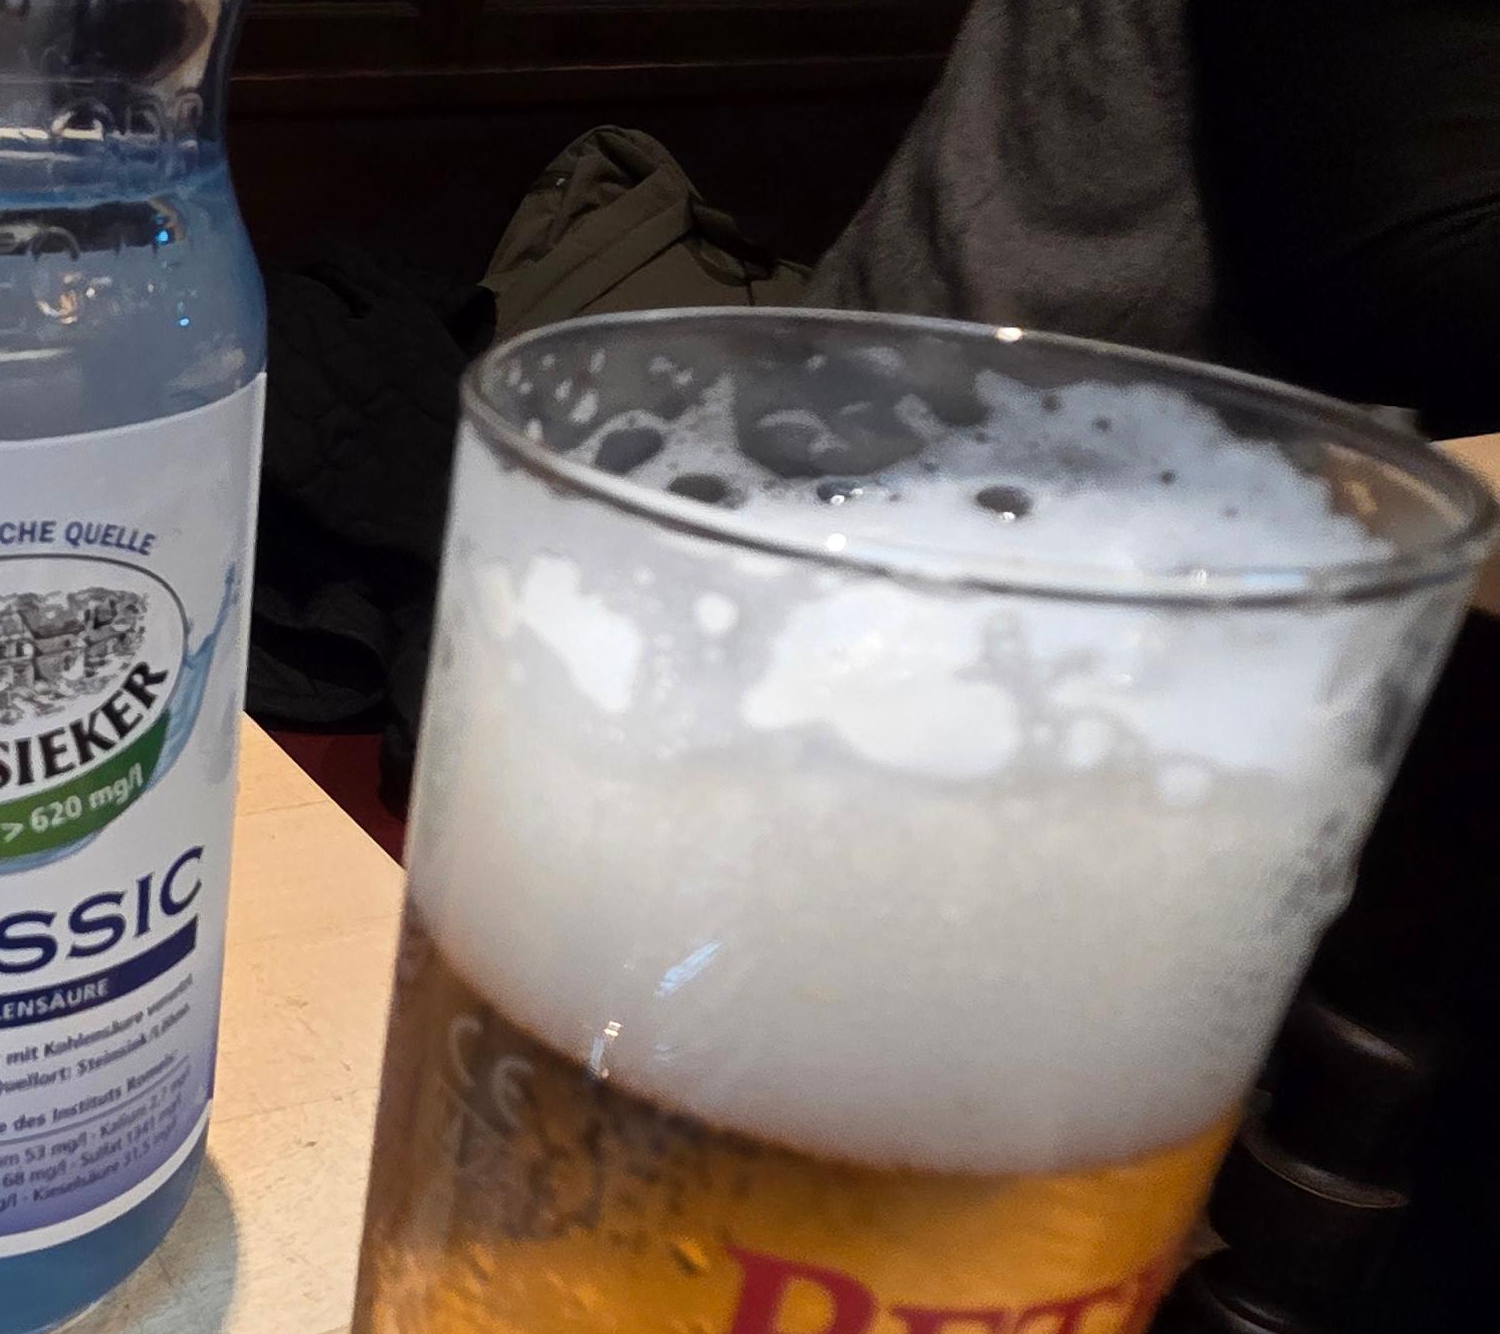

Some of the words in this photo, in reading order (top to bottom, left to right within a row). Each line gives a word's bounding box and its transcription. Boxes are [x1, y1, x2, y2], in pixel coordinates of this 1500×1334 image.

[64, 522, 158, 557] QUELLE
[30, 795, 83, 835] 620
[88, 762, 145, 813] mg/l
[6, 1045, 39, 1066] mit
[13, 1113, 47, 1132] des
